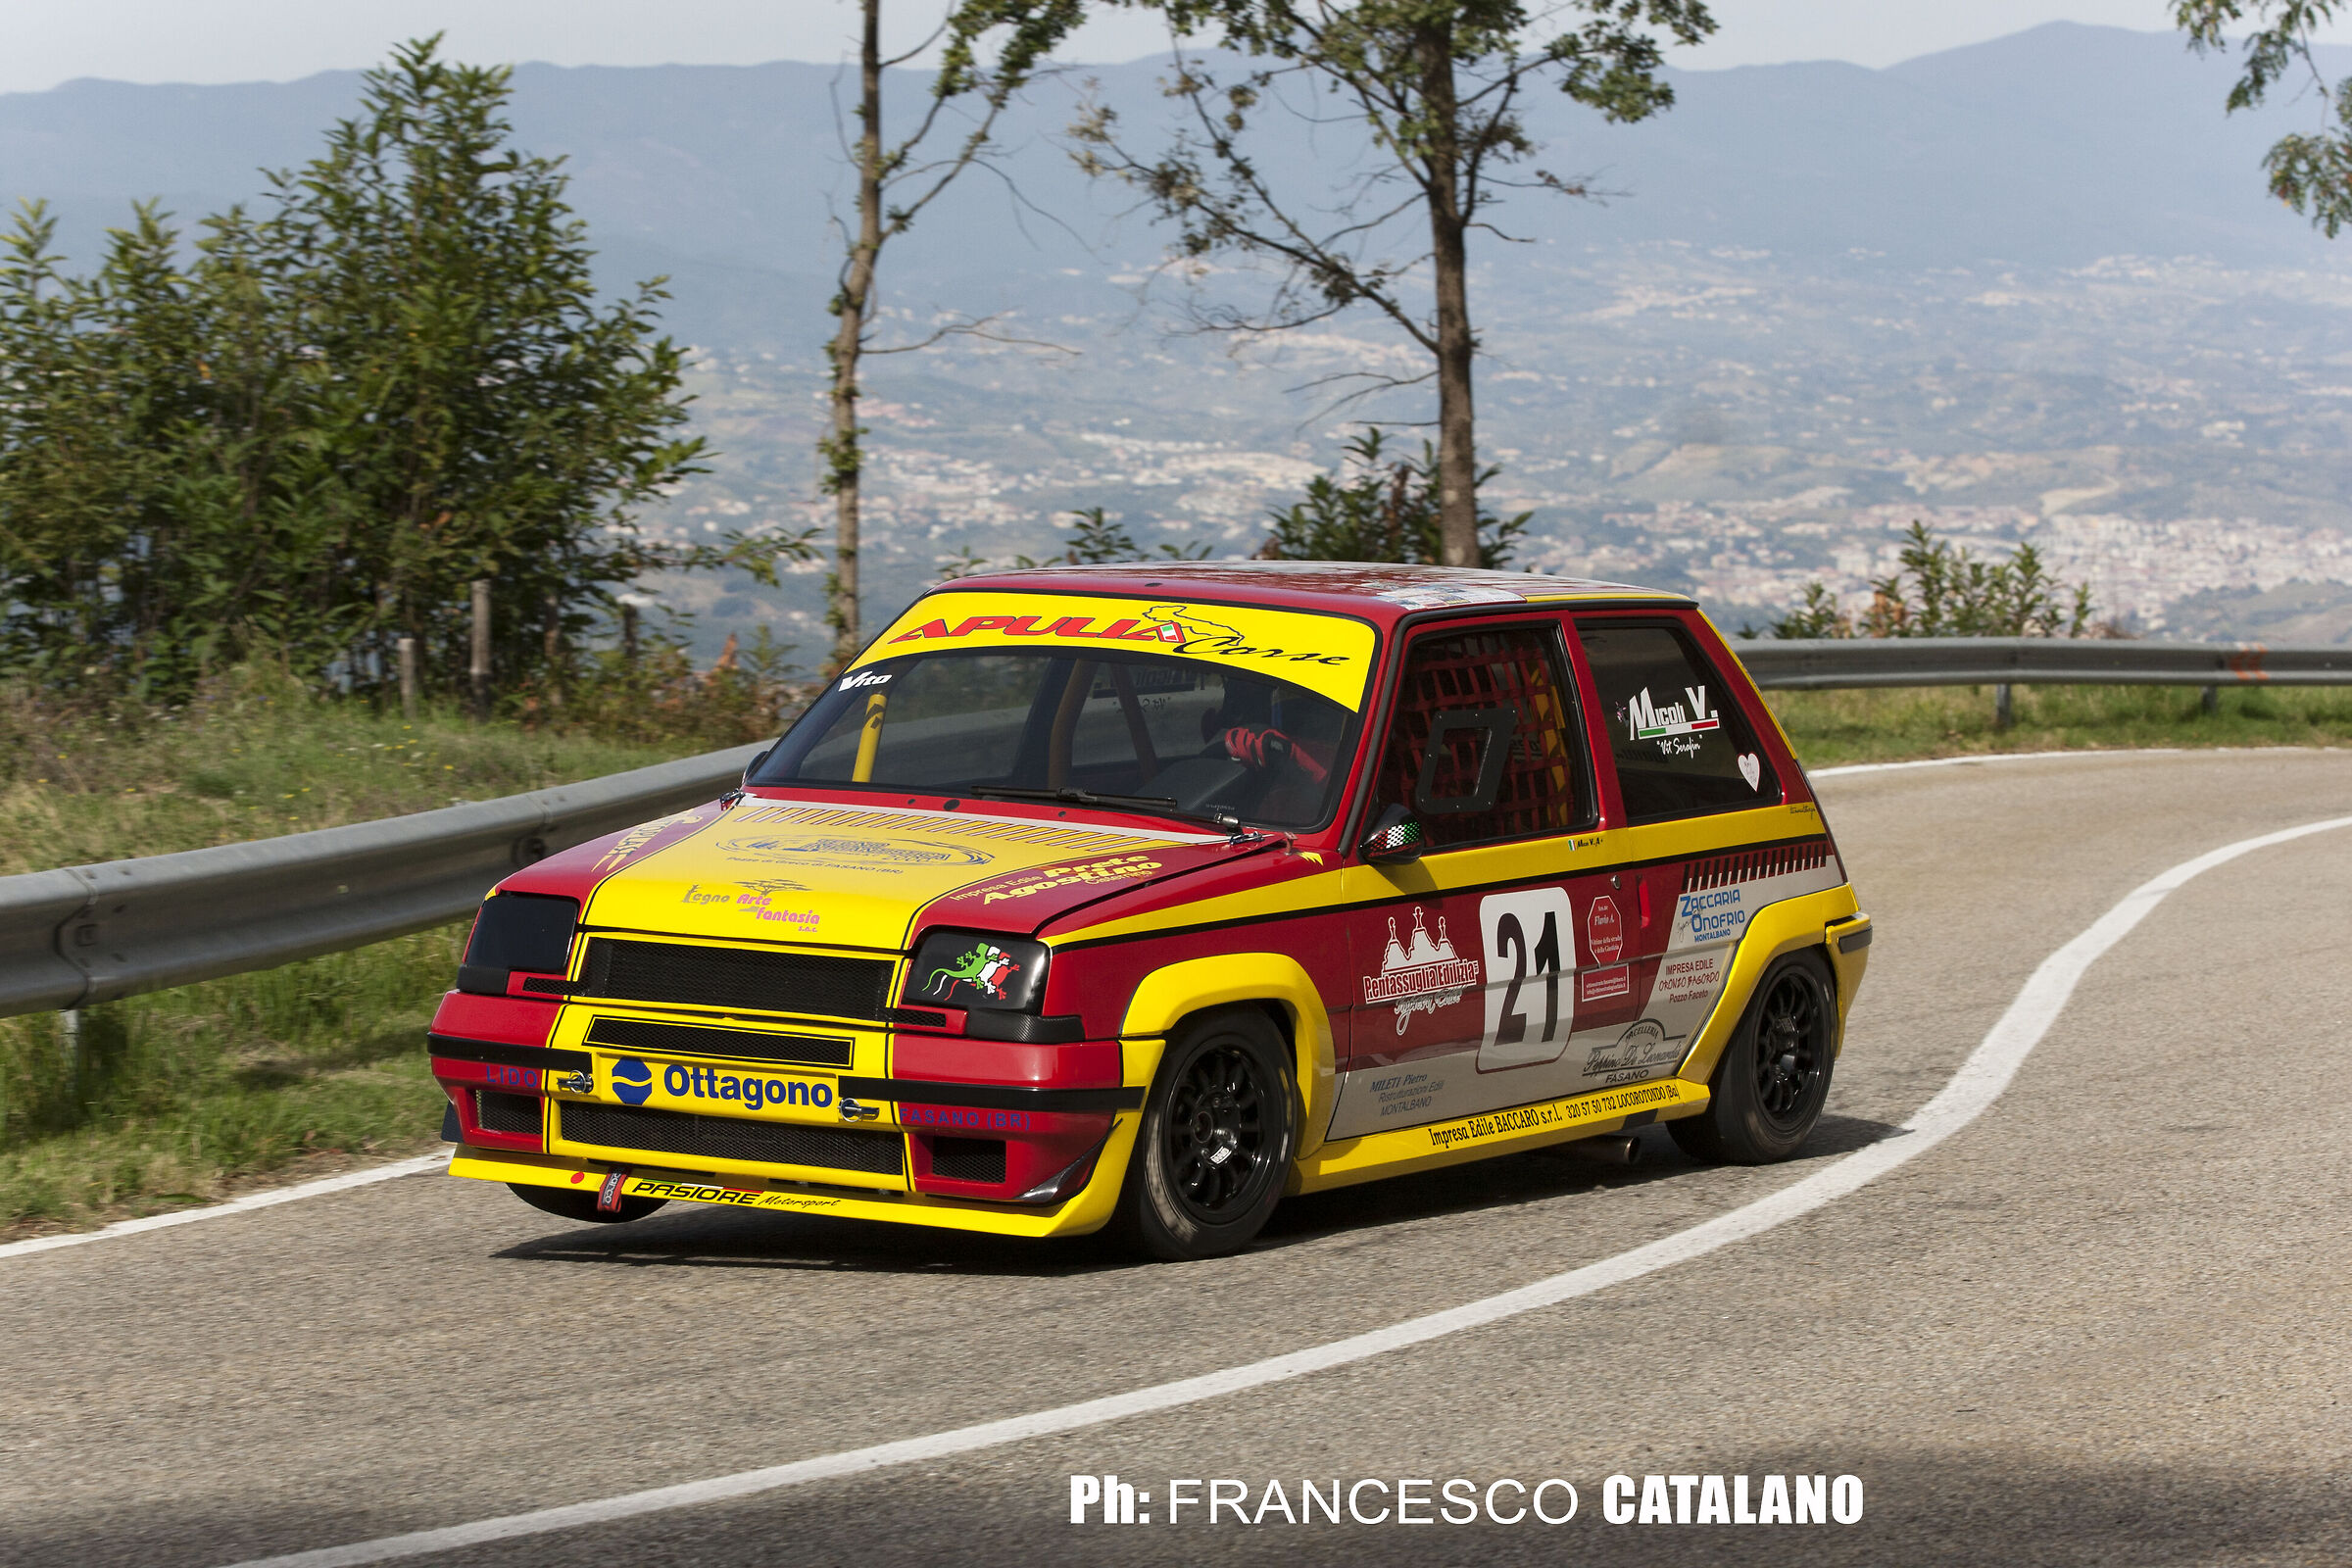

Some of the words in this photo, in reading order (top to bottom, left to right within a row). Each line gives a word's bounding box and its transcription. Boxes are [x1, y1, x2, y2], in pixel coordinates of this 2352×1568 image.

[887, 615, 1187, 644] APULIA
[1173, 636, 1350, 665] Corse
[838, 671, 893, 692] Vito
[1629, 686, 1686, 741] Micoli
[1685, 685, 1718, 719] V.
[1043, 855, 1151, 878] Prete
[983, 861, 1162, 906] Agostino
[737, 894, 772, 906] Arte
[1680, 889, 1740, 917] ZACCARIA
[756, 906, 820, 924] fantasia
[1694, 928, 1731, 943] MONTALBANO
[1666, 962, 1693, 975] IMPRESA
[1695, 958, 1713, 970] EDILE
[1363, 966, 1438, 999] Pentassuglia
[1438, 960, 1475, 987] Edilizia
[1494, 911, 1560, 1046] 21
[486, 1066, 537, 1088] LIDO
[663, 1064, 833, 1110] Ottagono
[1605, 1069, 1649, 1083] FASANO
[899, 1108, 979, 1126] FASANO
[987, 1113, 1030, 1130] (BR)
[1429, 1127, 1469, 1149] Impresa
[1468, 1117, 1494, 1138] Edile
[1494, 1108, 1540, 1133] BACCARO
[1542, 1103, 1563, 1124] s.r.l.
[1565, 1104, 1582, 1119] 320
[1582, 1102, 1592, 1115] 57
[1592, 1100, 1601, 1113] 50
[1601, 1096, 1617, 1111] 732
[1615, 1086, 1667, 1108] LOCOROTONDO
[758, 1194, 841, 1208] Motorsport
